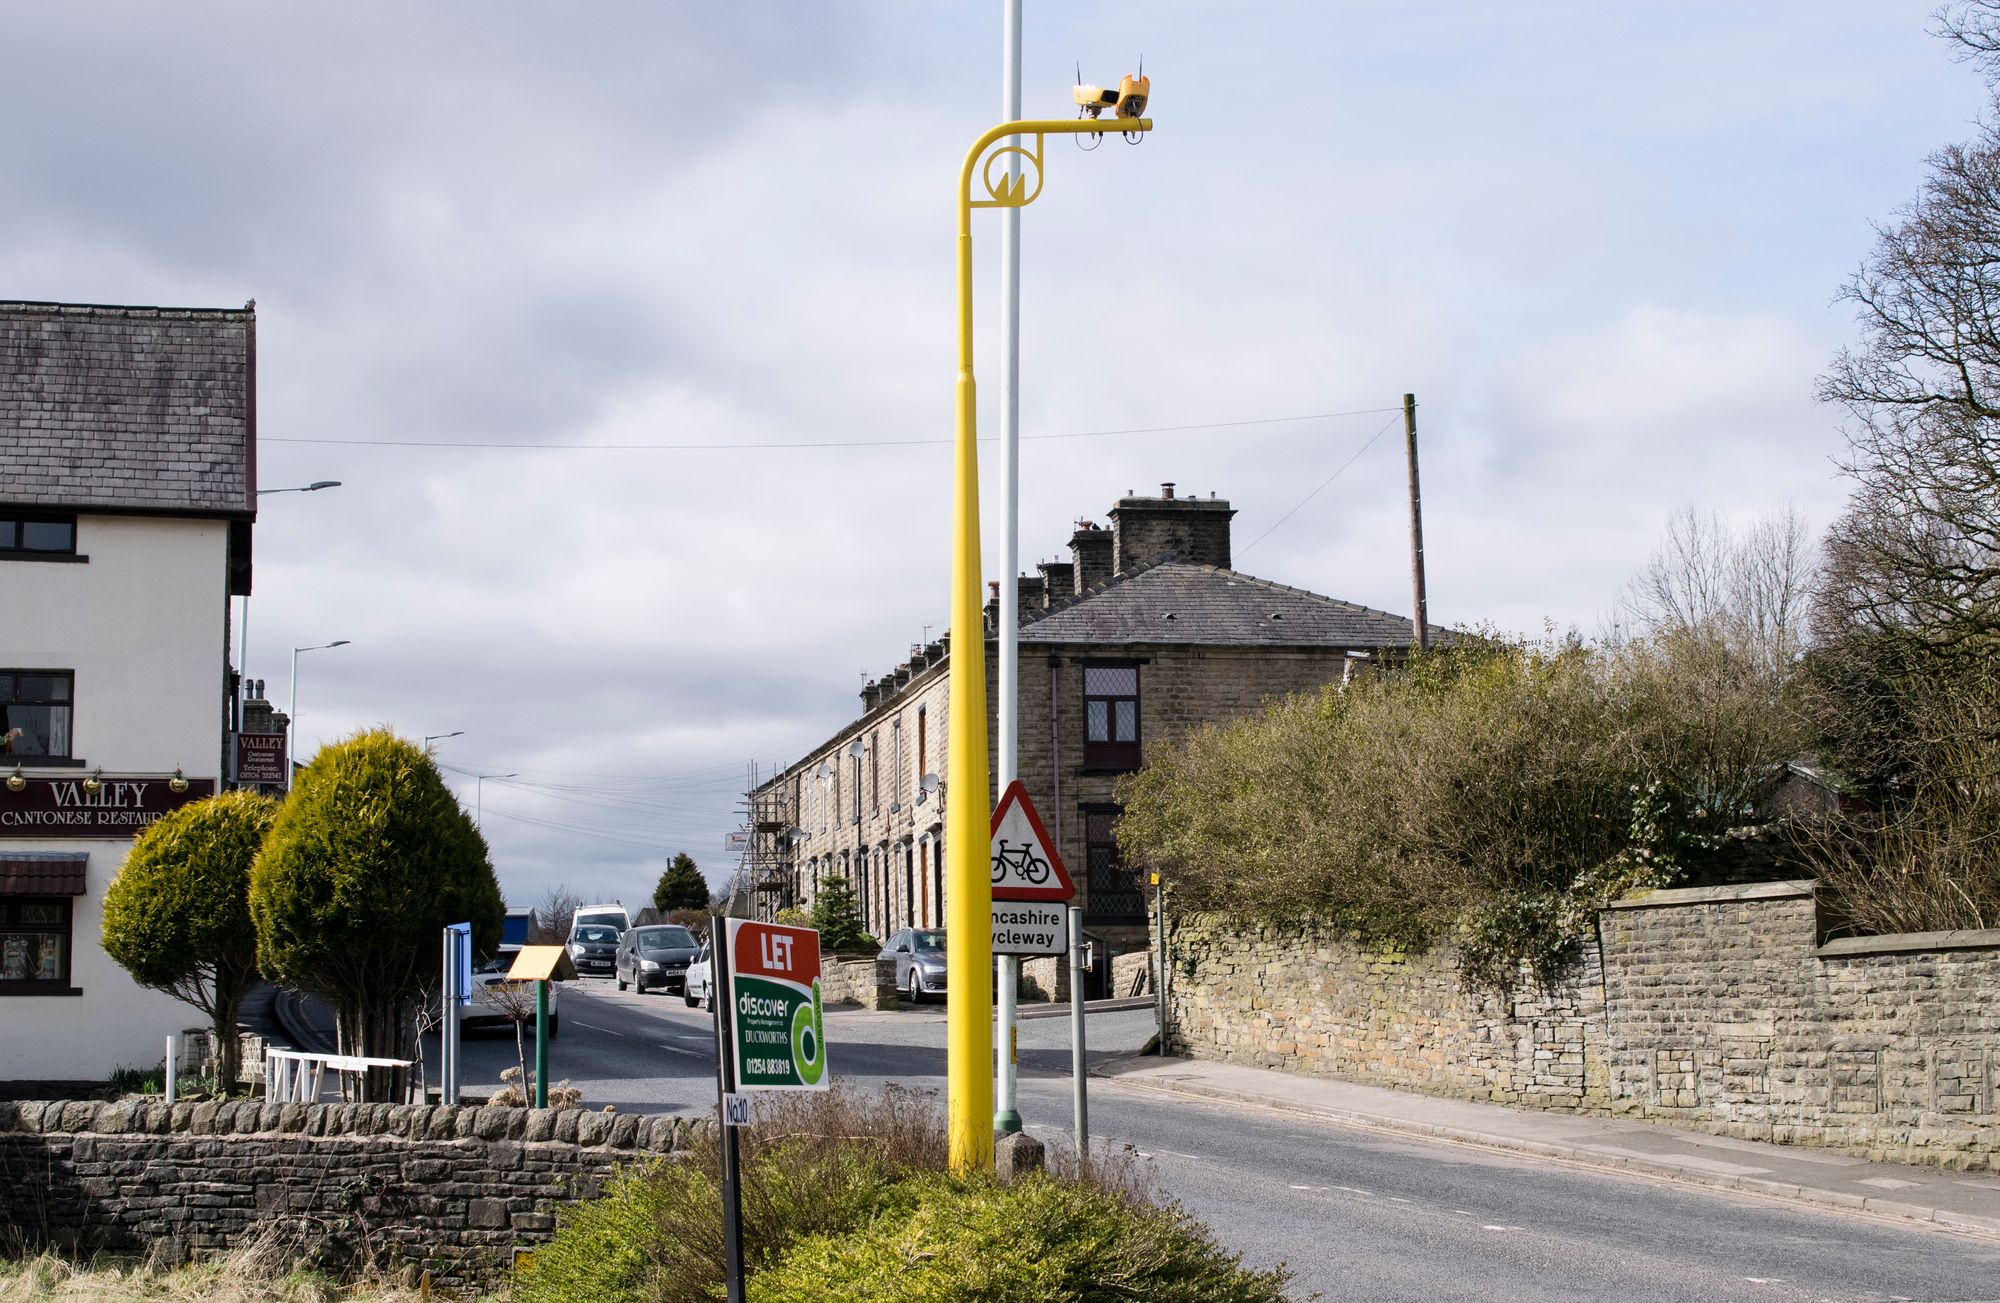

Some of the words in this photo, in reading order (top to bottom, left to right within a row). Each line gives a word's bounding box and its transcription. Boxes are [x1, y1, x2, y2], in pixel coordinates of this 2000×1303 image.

[240, 737, 283, 749] VALLEY
[49, 781, 149, 808] VALLEY
[1, 811, 92, 826] CANTONESE
[760, 932, 793, 971] LET
[739, 992, 789, 1017] discover
[815, 988, 823, 1050] discover
[745, 1030, 788, 1044] DUCKWORTHS
[746, 1058, 766, 1074] 01254
[767, 1059, 790, 1075] 883819
